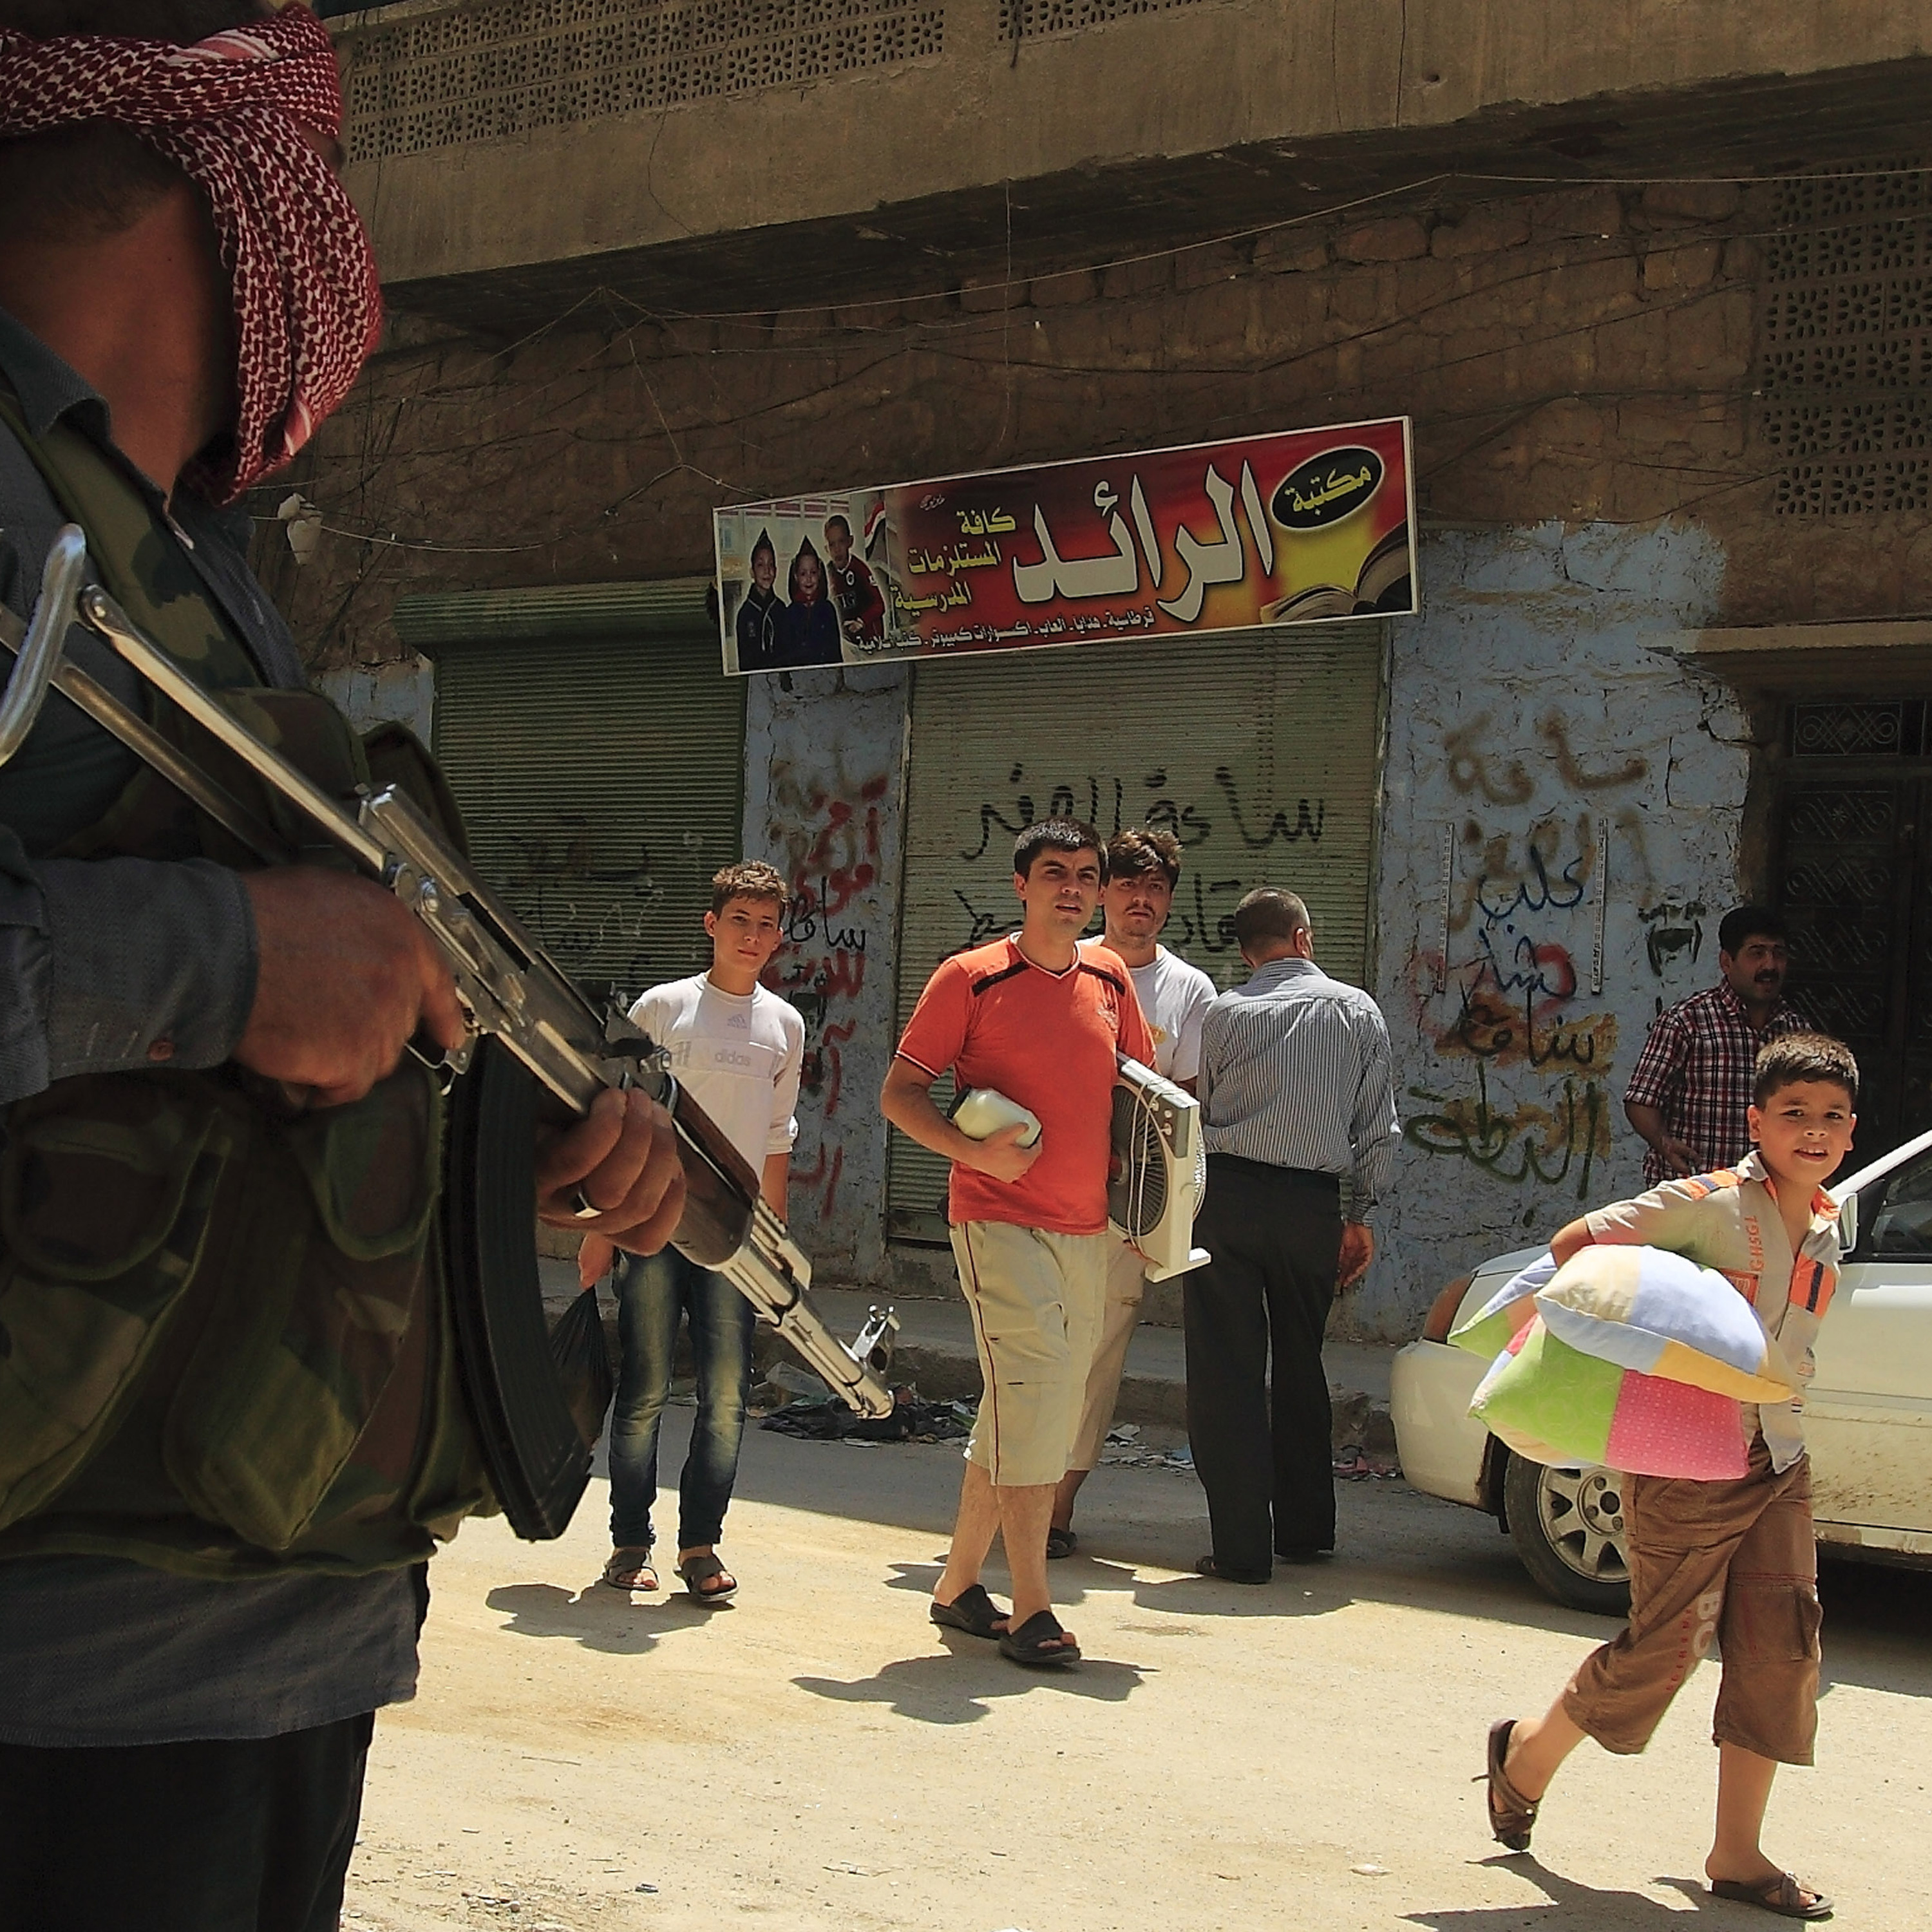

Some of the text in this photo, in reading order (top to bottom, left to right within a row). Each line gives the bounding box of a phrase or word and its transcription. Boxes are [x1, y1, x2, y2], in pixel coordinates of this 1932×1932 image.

[1284, 464, 1371, 516] مكتبة
[956, 506, 1016, 535] كافة
[1012, 459, 1273, 623] الرائد
[909, 540, 1001, 576] المستلزمات
[890, 581, 972, 617] المدرسية
[1072, 615, 1101, 634] هدايا
[1105, 606, 1155, 631] قرطاسية
[896, 632, 923, 652] كتب
[931, 627, 973, 648] كمبيوتر
